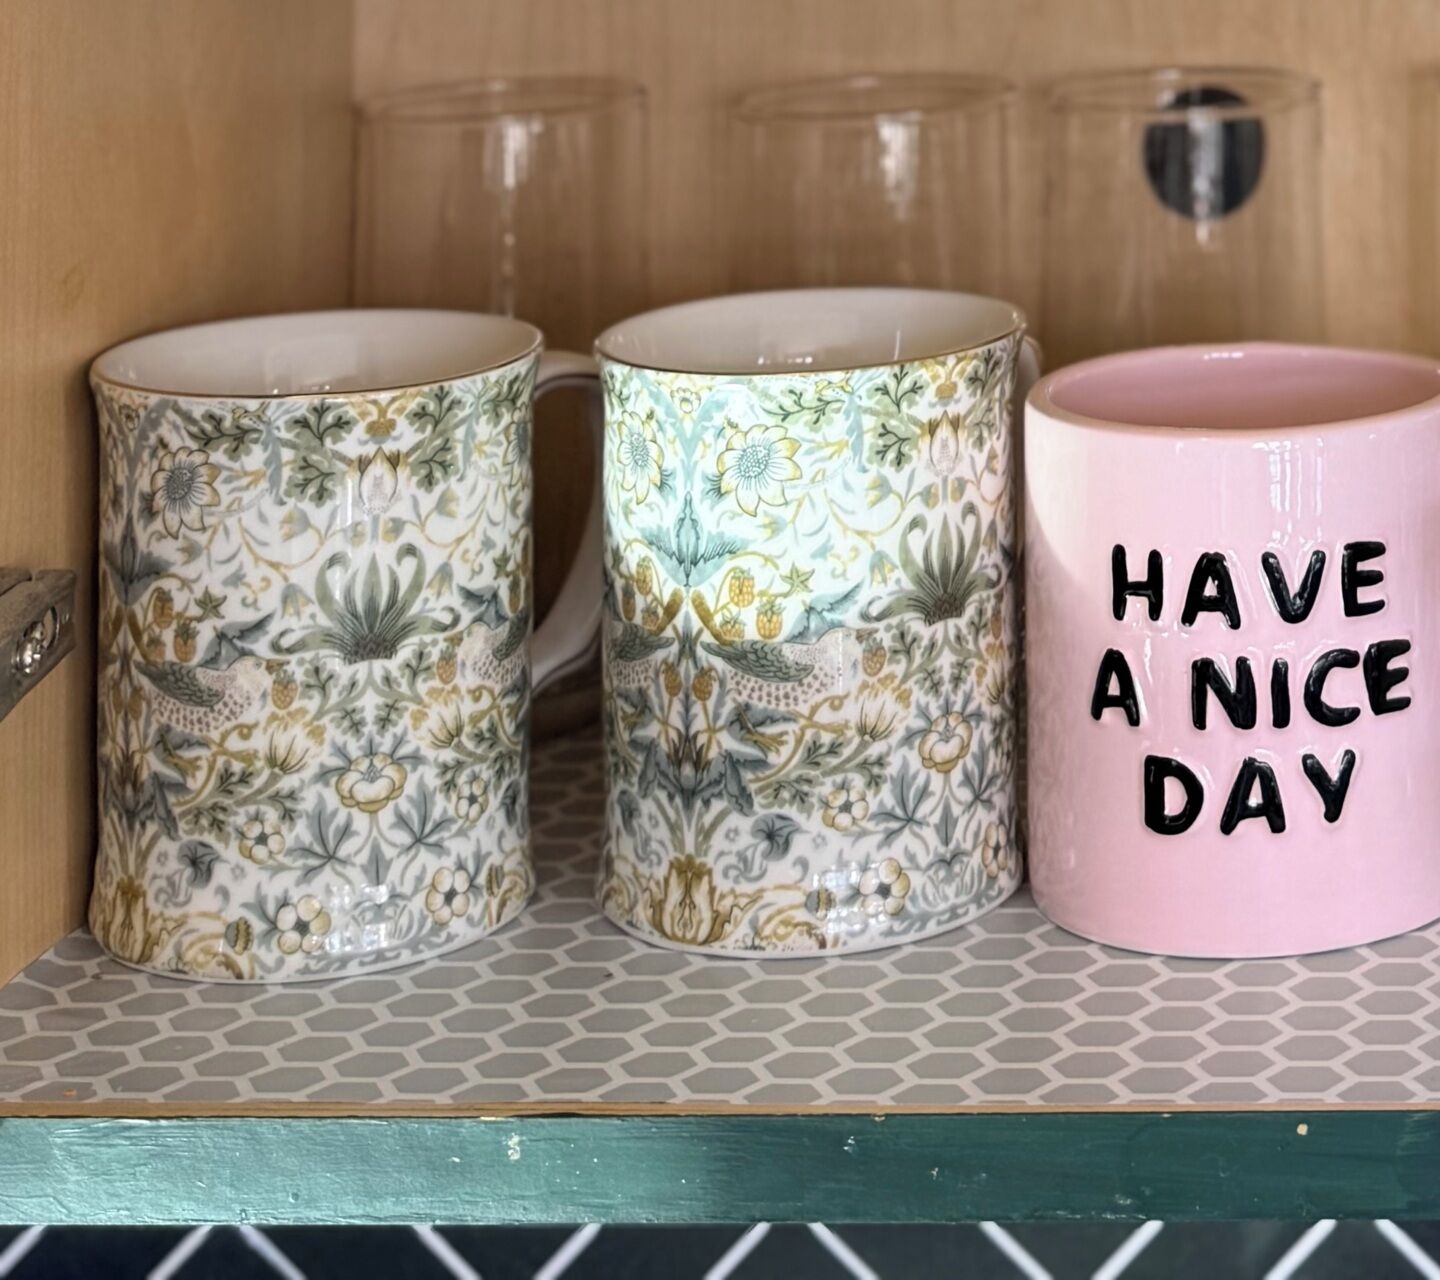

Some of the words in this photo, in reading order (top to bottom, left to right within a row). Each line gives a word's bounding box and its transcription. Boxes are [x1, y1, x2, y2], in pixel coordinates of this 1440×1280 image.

[1111, 540, 1386, 630] HAVE
[1091, 648, 1140, 727] A
[1191, 638, 1411, 730] NICE
[1144, 749, 1356, 836] DAY
